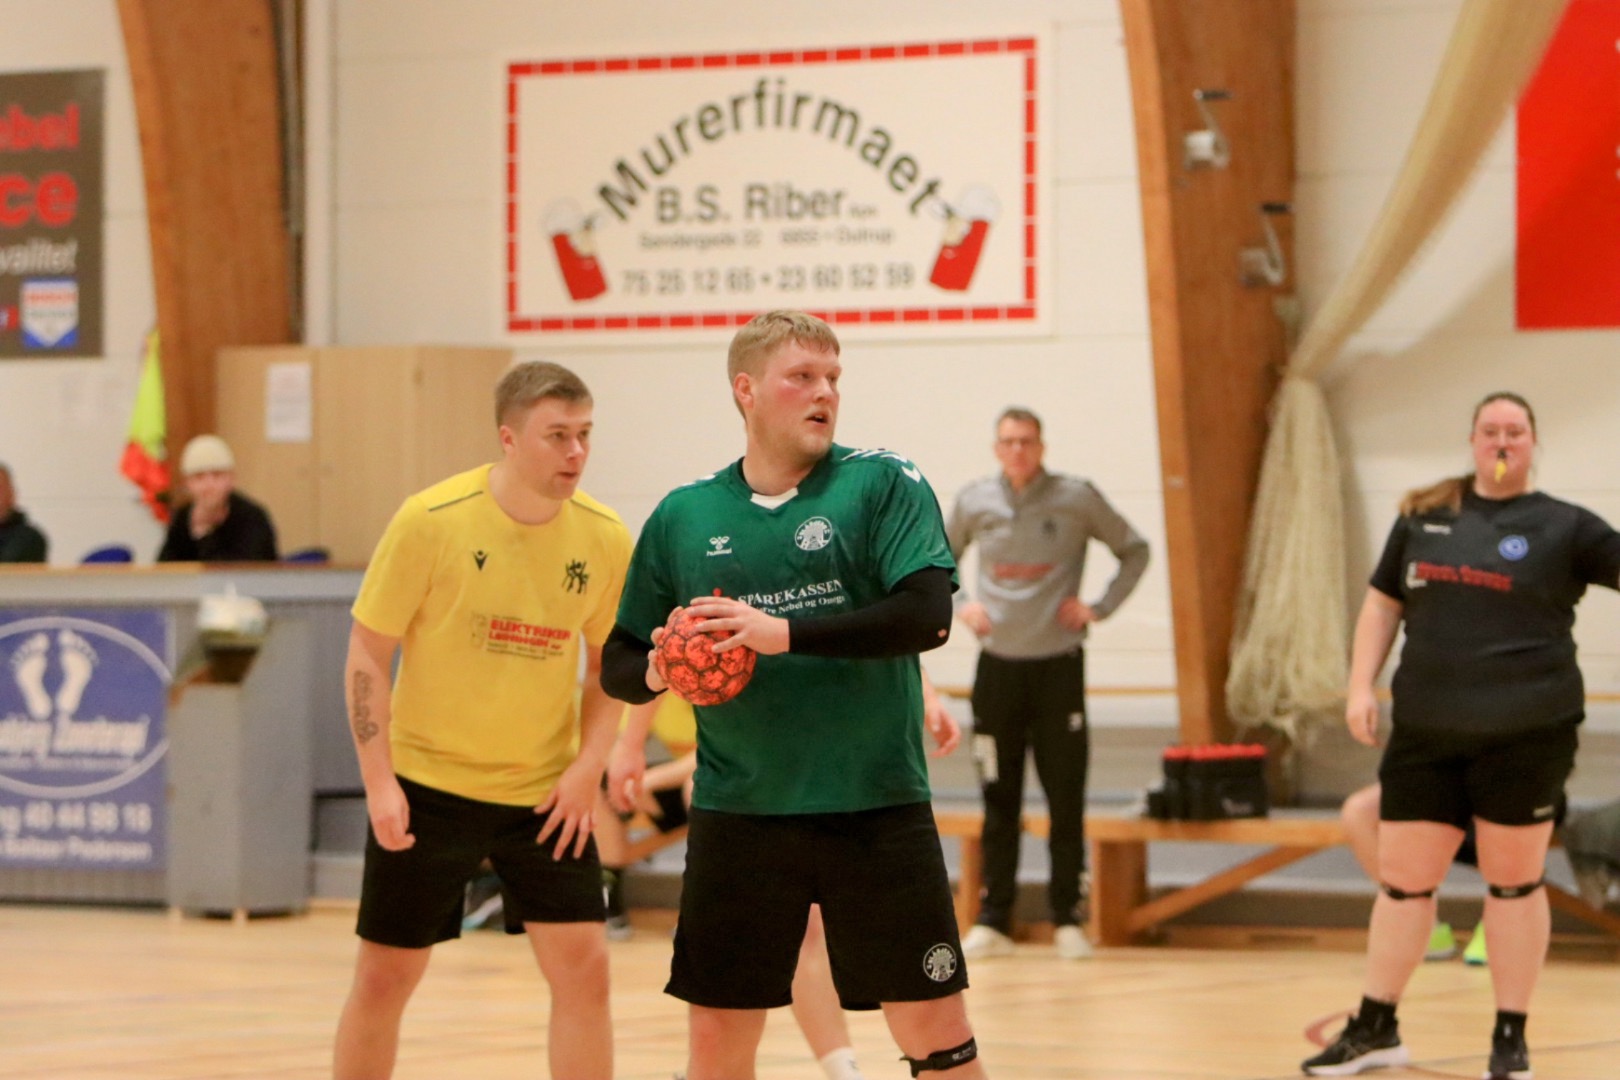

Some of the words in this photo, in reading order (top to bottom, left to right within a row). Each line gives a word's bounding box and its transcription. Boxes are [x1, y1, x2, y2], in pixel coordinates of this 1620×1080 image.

[599, 77, 943, 220] Murerfirmaet
[656, 185, 731, 223] B.S.
[745, 181, 845, 220] Riber
[778, 601, 803, 613] Nebel
[804, 600, 817, 608] og
